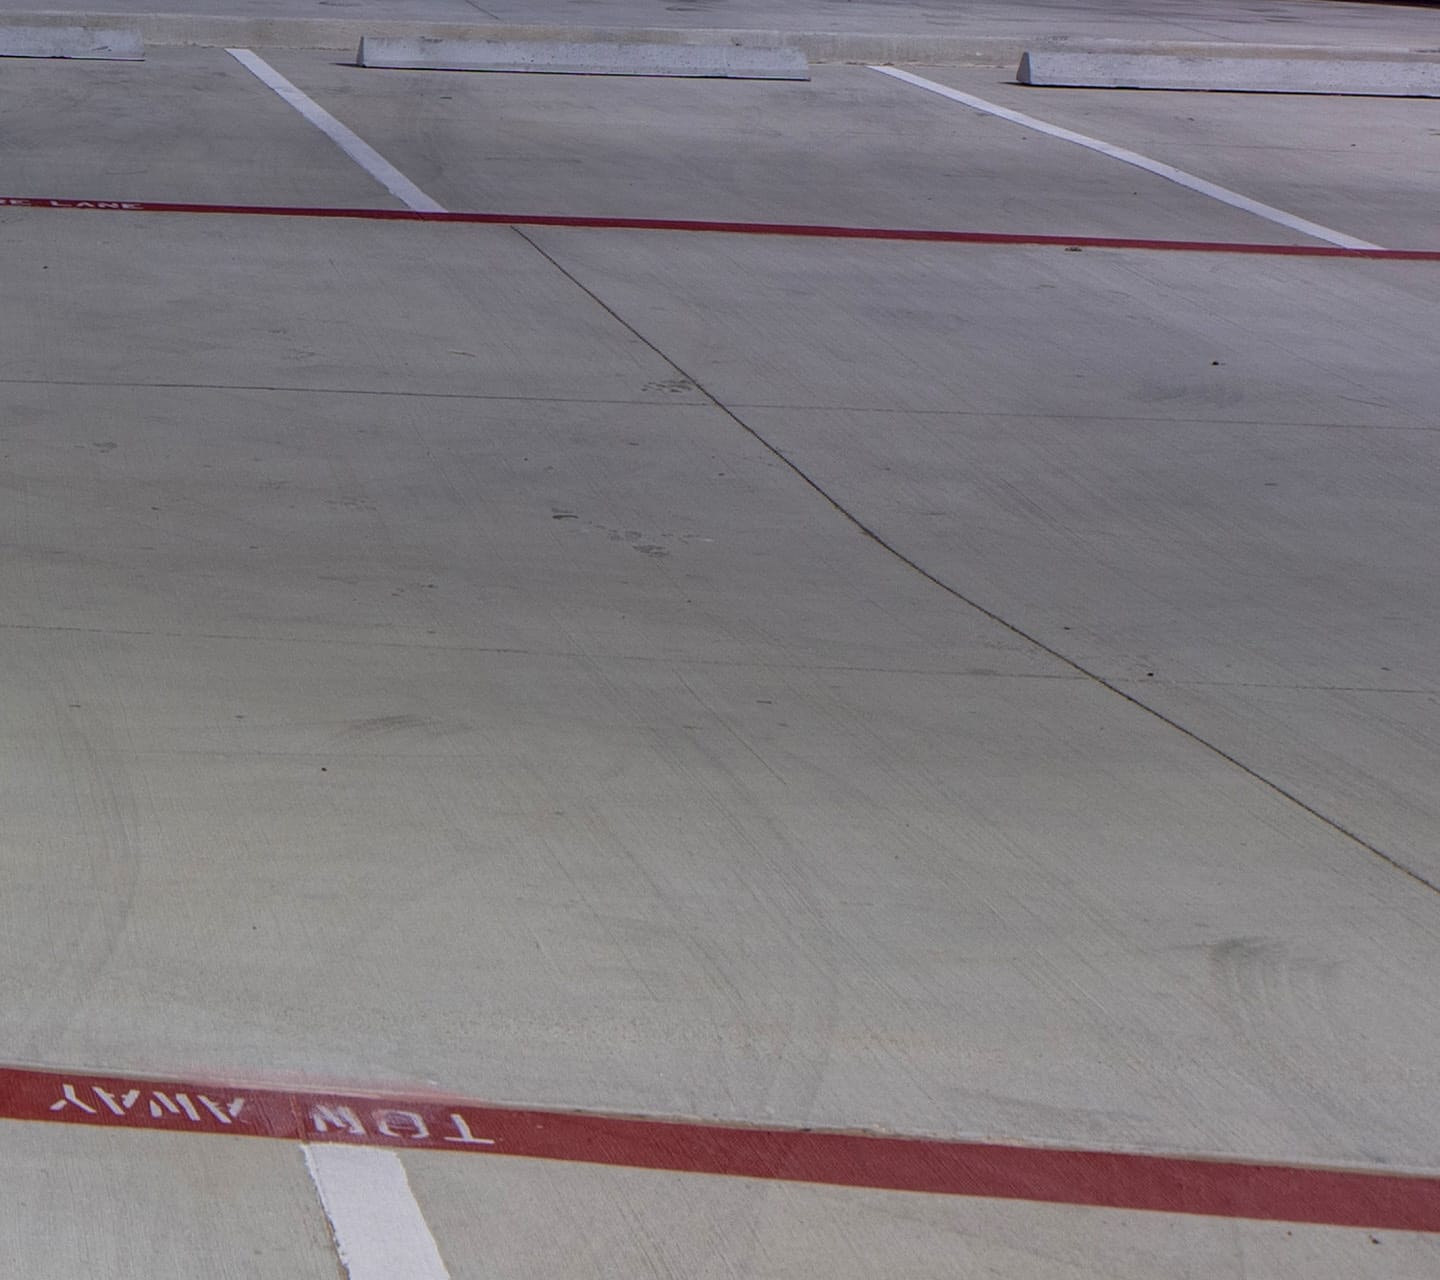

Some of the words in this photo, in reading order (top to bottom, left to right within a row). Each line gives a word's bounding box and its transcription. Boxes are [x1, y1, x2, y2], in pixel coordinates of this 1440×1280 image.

[50, 200, 144, 210] LANE
[49, 1083, 245, 1124] AWAY
[309, 1104, 495, 1145] TOW
